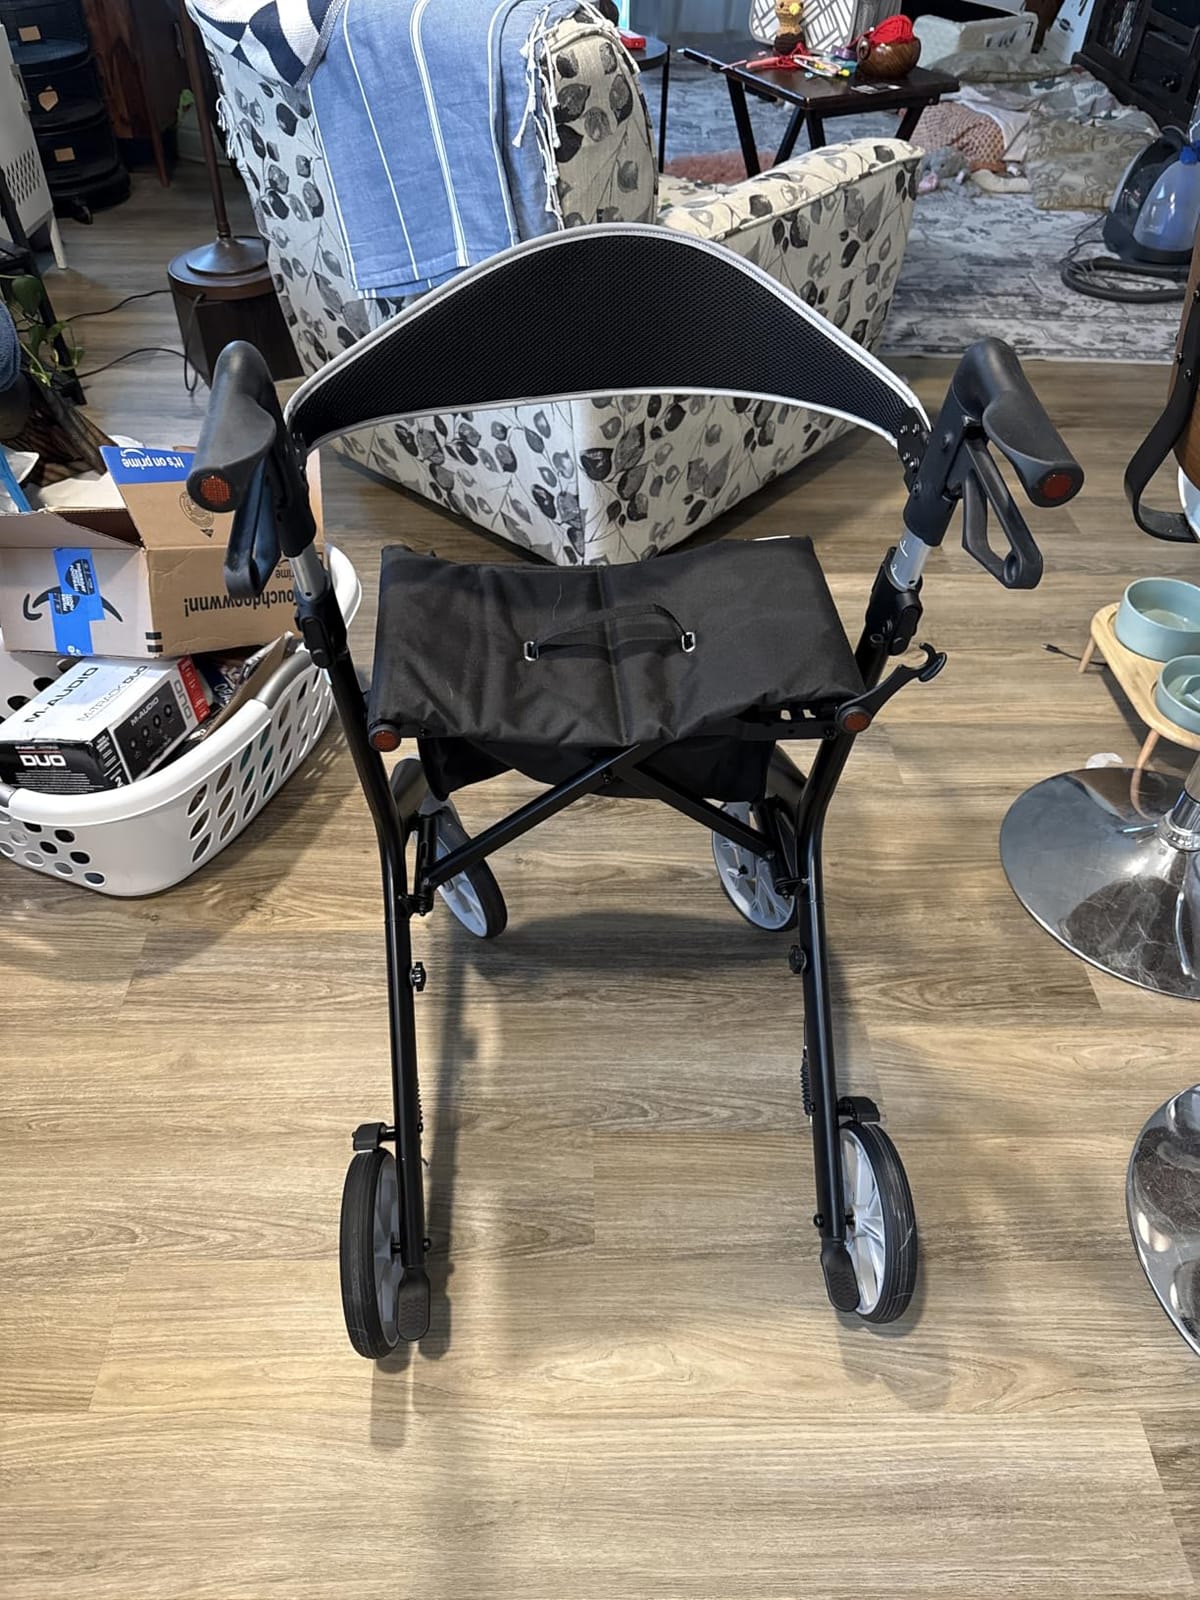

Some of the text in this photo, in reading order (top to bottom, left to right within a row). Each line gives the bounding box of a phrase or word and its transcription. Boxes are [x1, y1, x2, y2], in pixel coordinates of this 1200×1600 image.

[121, 455, 185, 470] It's on prime
[275, 568, 295, 581] rime
[183, 589, 297, 617] ouchdoowwnn!
[23, 667, 99, 723] M-AUDIO
[174, 680, 192, 720] DUO
[130, 696, 159, 727] M-AUDIO
[19, 754, 67, 767] DUO
